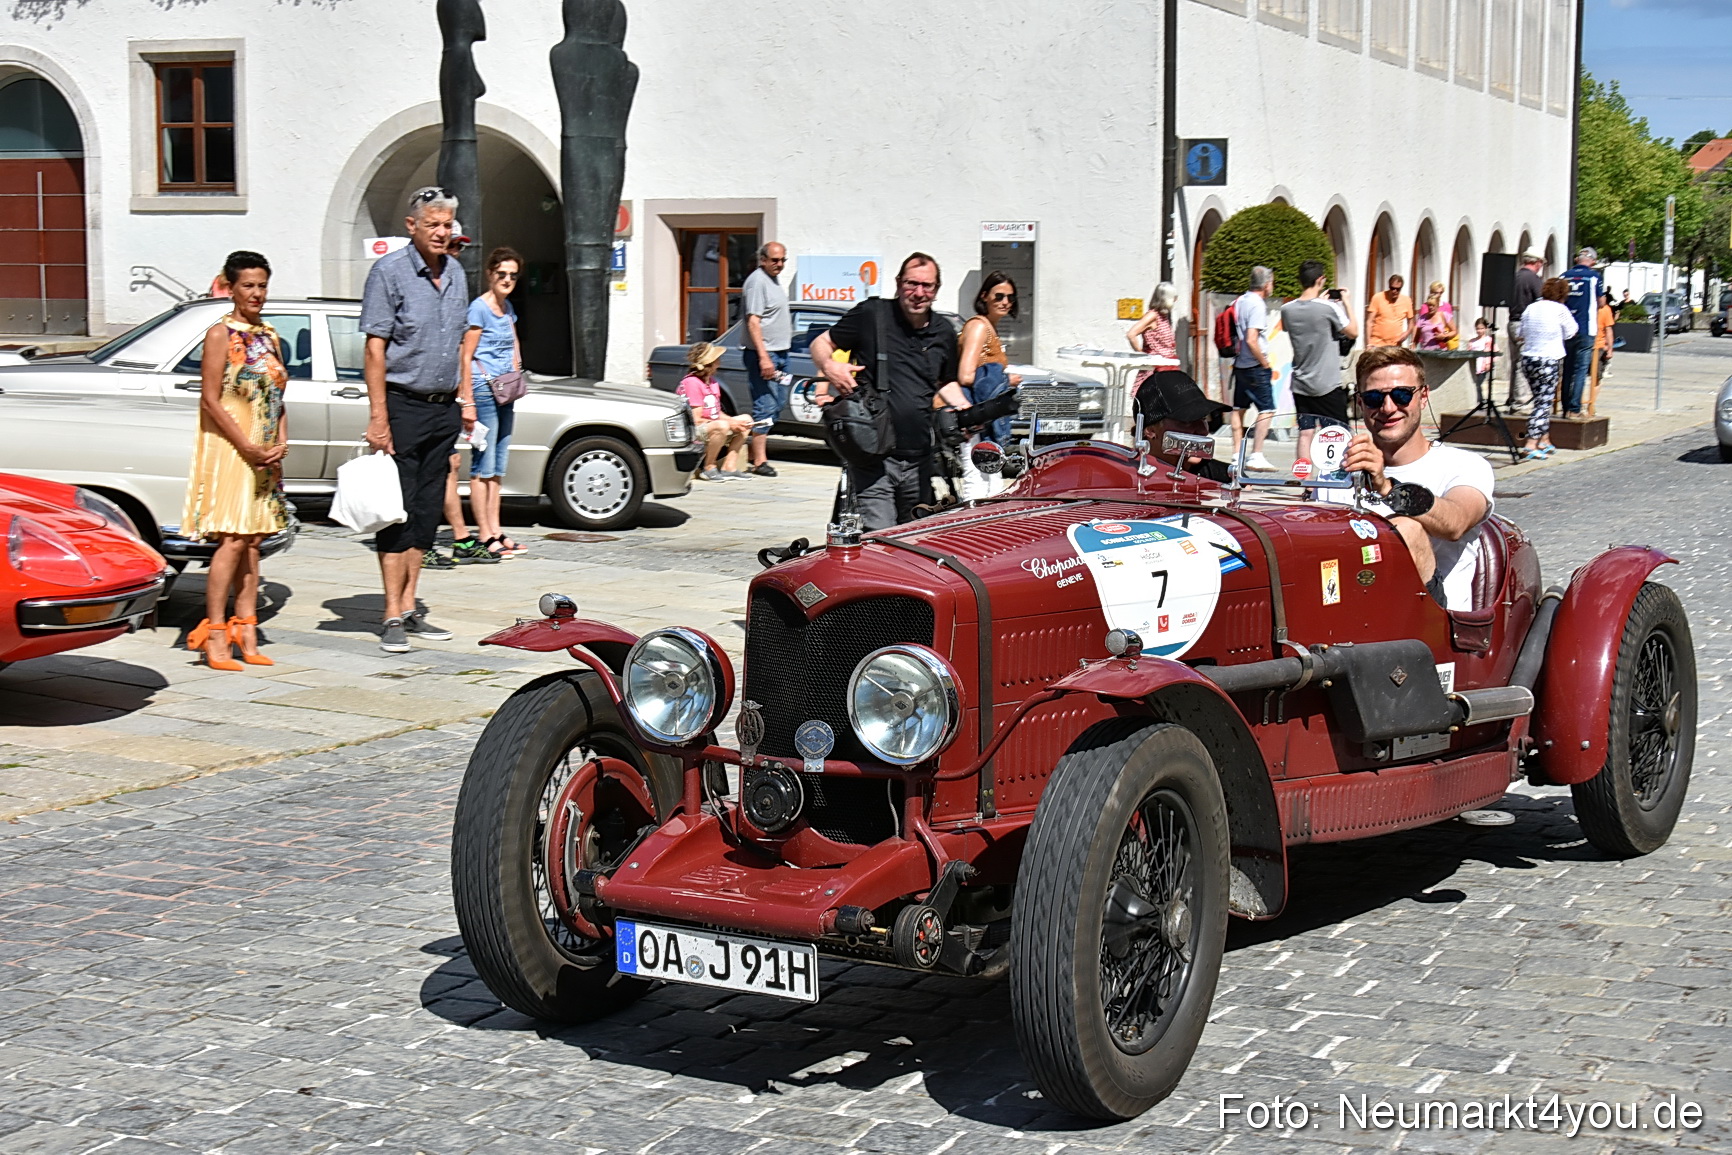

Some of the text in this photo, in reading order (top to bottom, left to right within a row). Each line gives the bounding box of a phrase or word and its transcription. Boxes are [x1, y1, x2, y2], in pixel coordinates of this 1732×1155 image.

[983, 223, 1026, 231] NEUMARKT
[802, 284, 856, 300] Kunst
[1326, 444, 1335, 459] 6
[1056, 573, 1084, 588] GENEVE
[1151, 570, 1168, 608] 7
[623, 951, 631, 964] D
[638, 929, 812, 995] OA J 91H
